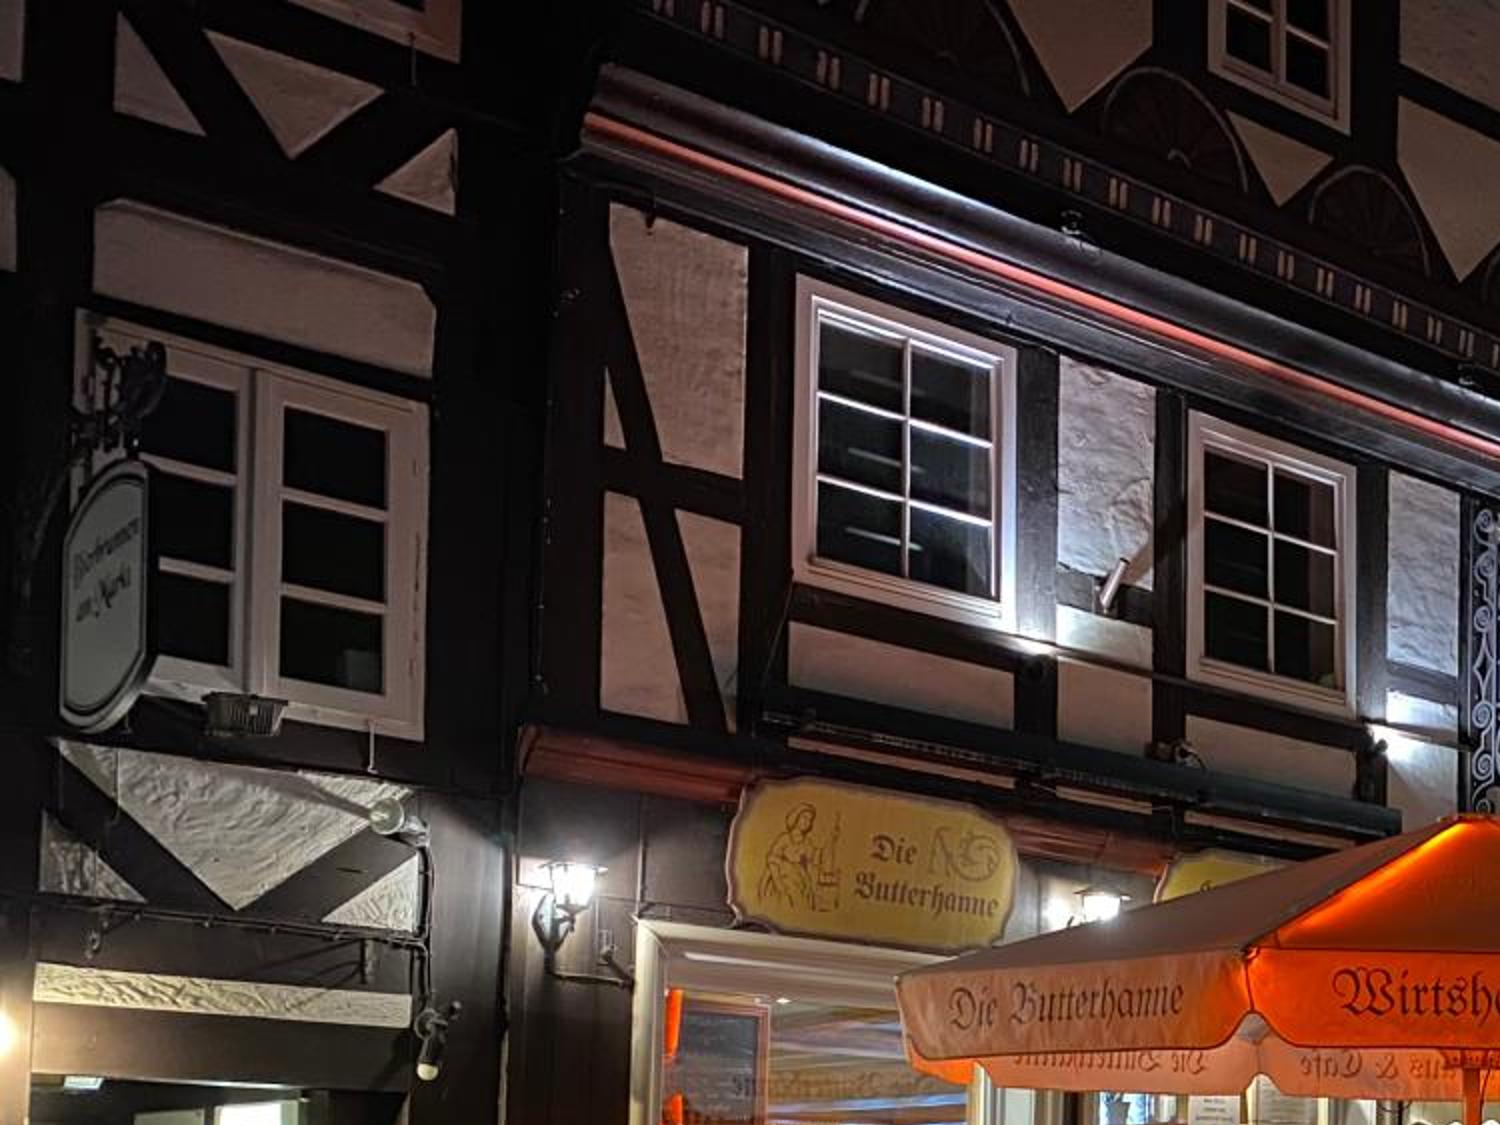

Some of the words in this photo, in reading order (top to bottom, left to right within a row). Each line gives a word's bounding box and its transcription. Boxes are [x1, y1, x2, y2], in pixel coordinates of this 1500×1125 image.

[871, 833, 918, 866] Die
[853, 869, 999, 919] Butterhanne
[950, 986, 999, 1031] Die
[1010, 977, 1185, 1027] Butterhanne
